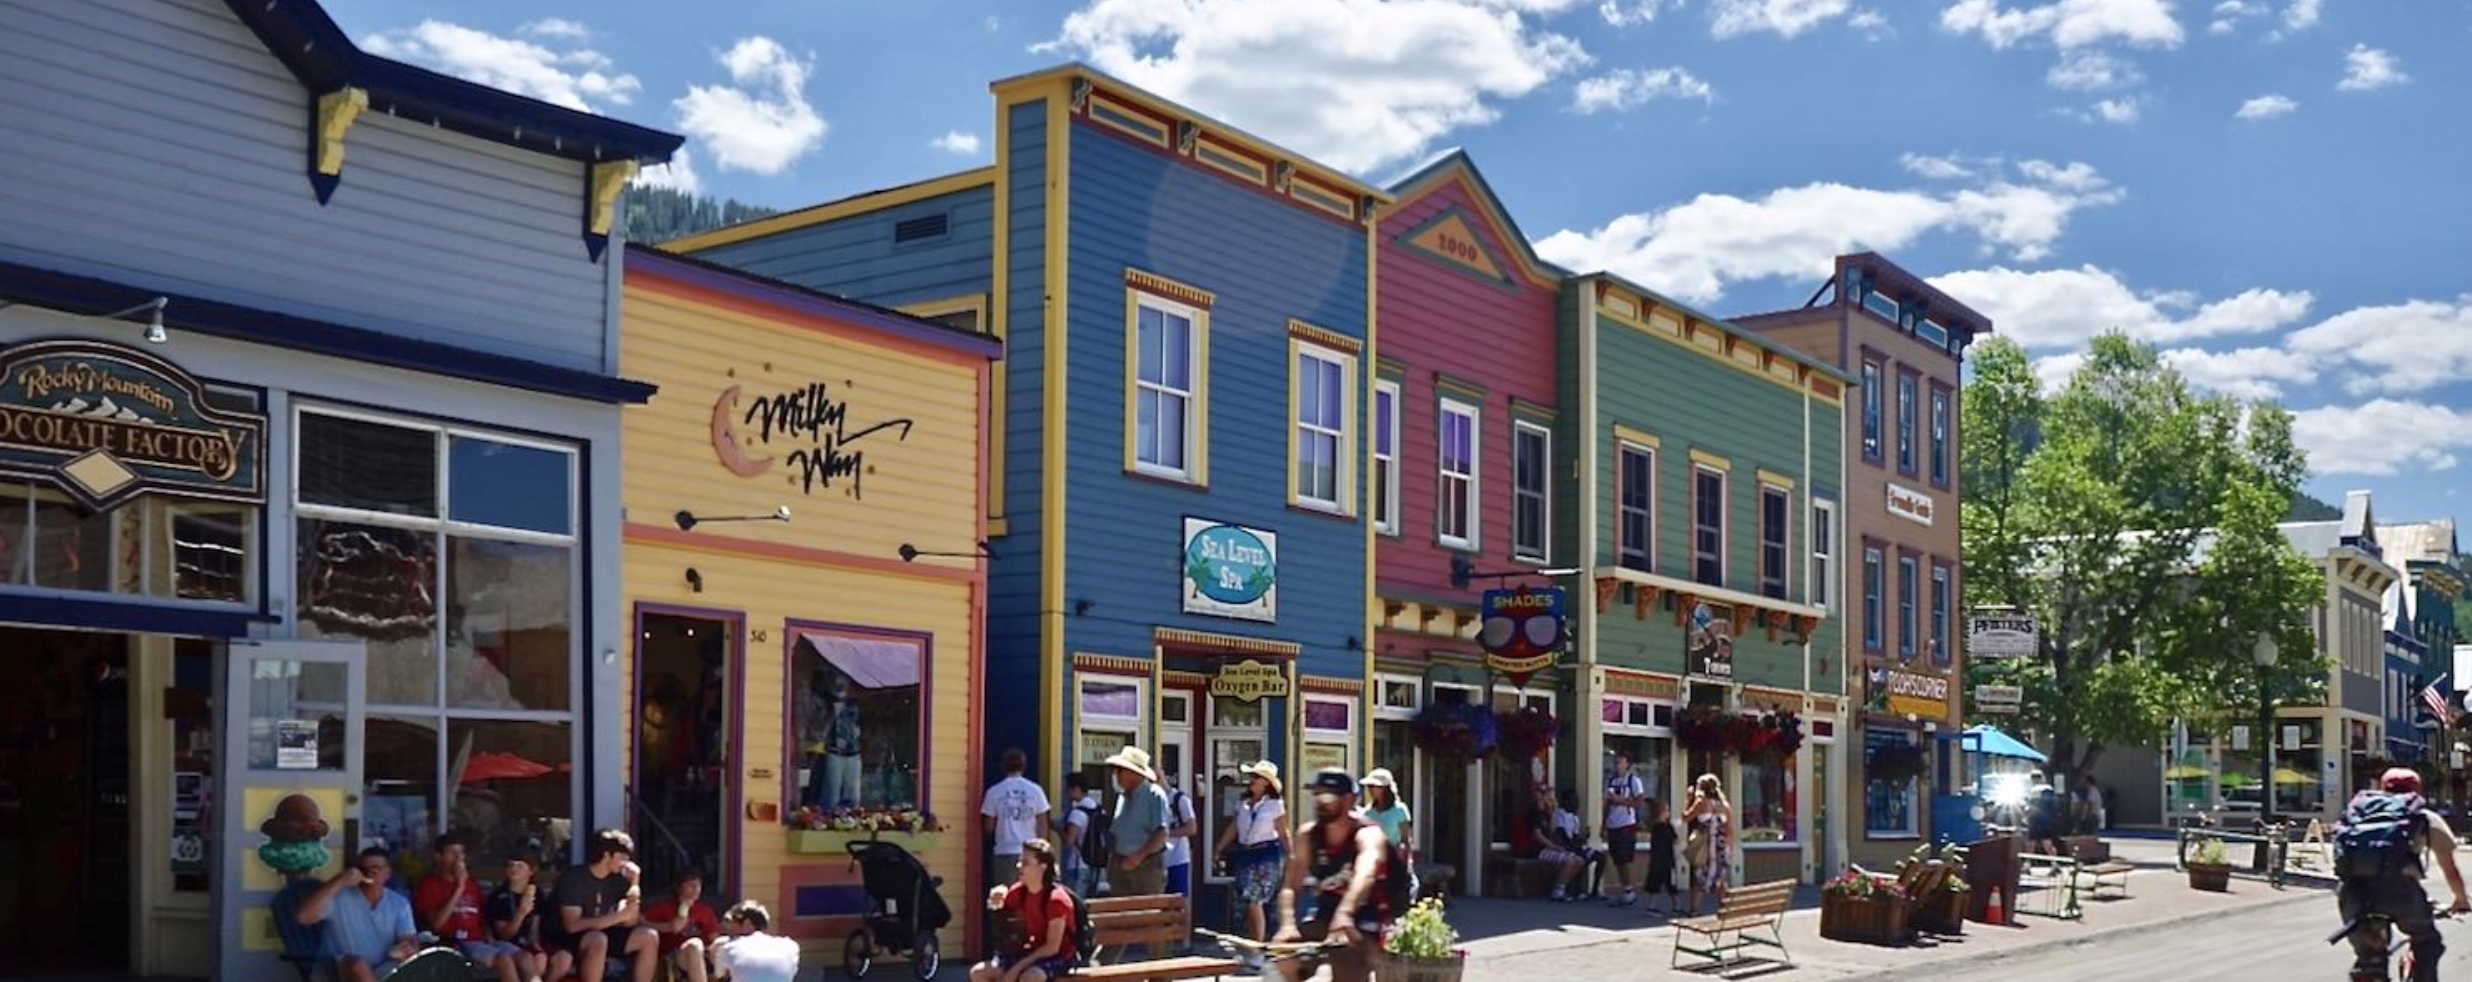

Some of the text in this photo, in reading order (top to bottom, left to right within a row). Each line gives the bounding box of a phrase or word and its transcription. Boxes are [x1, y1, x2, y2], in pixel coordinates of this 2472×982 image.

[1438, 233, 1478, 262] 2000
[18, 362, 174, 415] Rocky Mountain
[744, 382, 912, 447] Milky
[126, 426, 247, 481] FACTORY
[786, 432, 863, 501] Way
[1492, 594, 1554, 609] SHADES
[1215, 679, 1285, 695] Oxygen Bar
